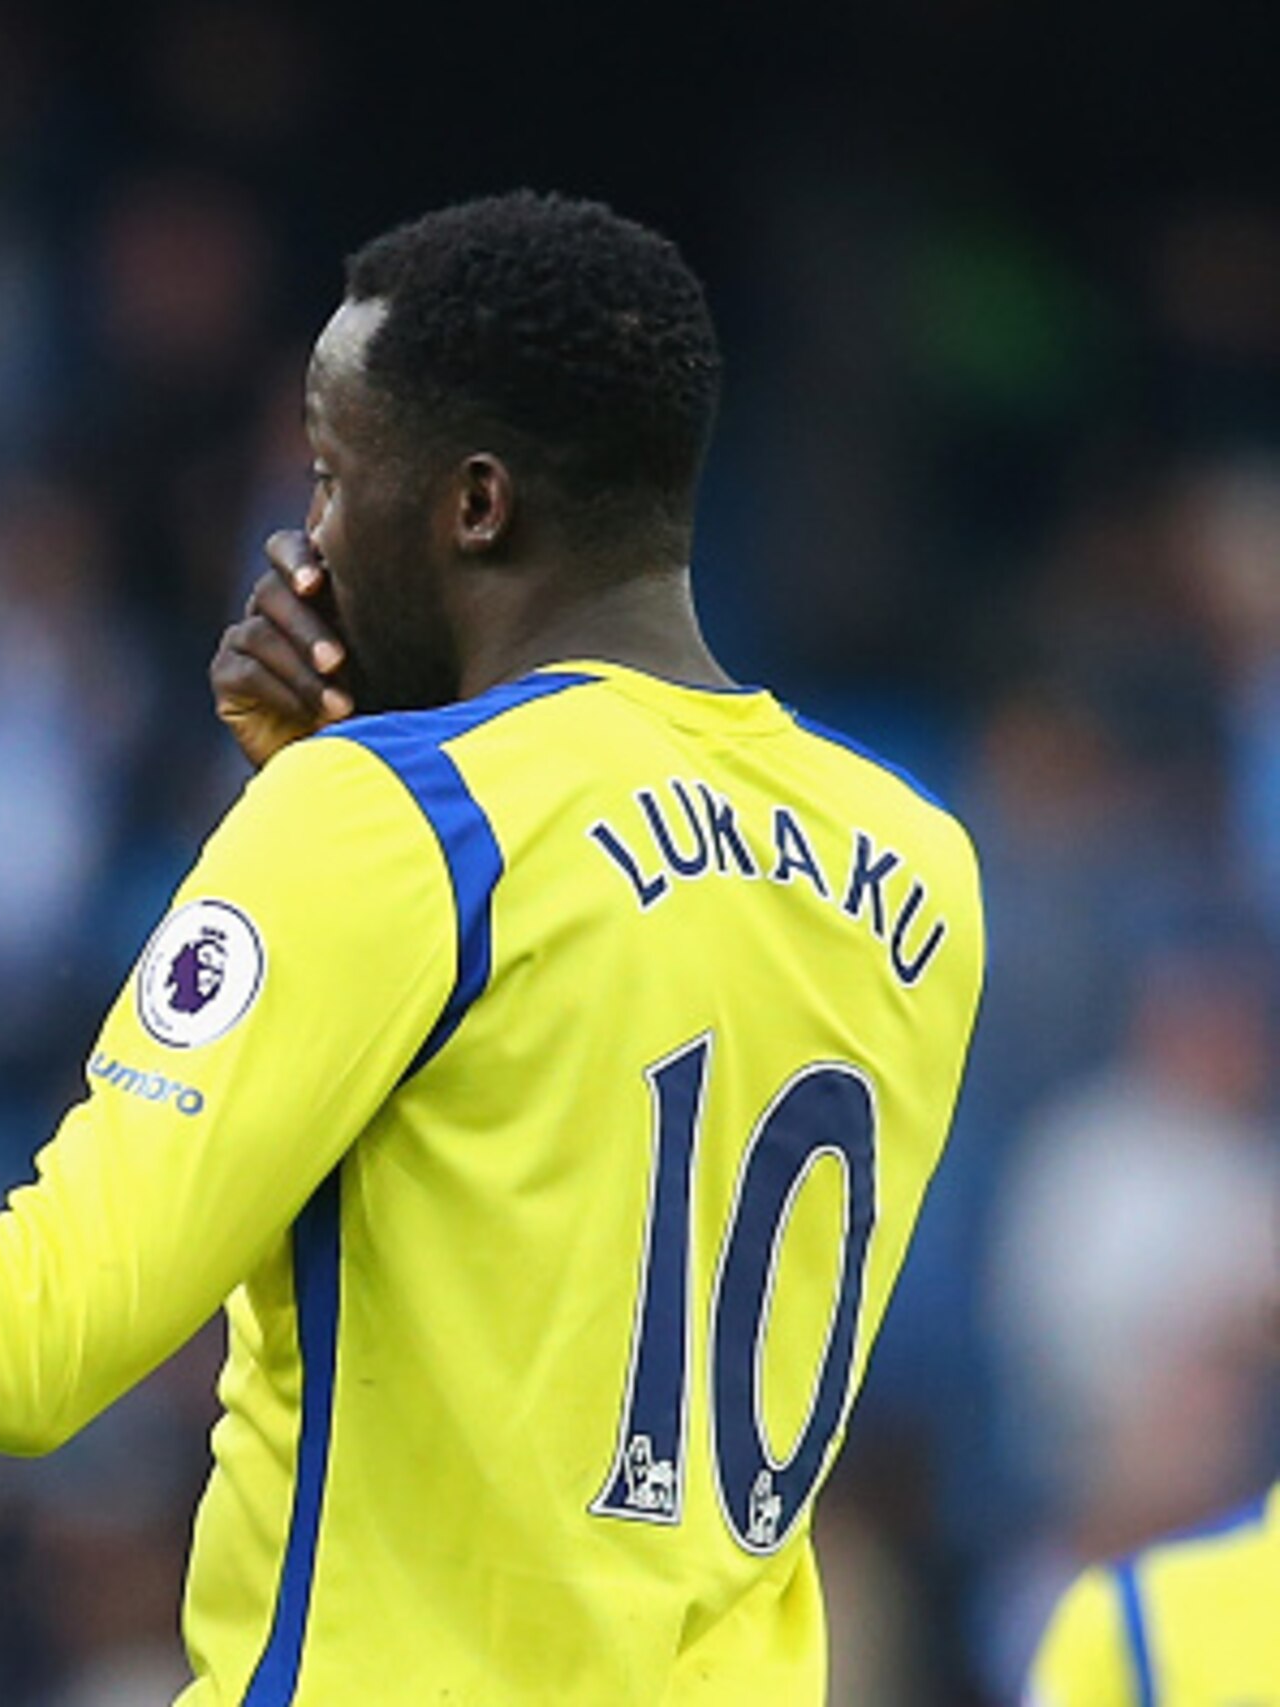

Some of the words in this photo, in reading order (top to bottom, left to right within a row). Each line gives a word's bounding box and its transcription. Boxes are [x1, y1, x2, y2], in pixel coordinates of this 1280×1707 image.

[589, 780, 946, 985] LUKAKU
[89, 1054, 204, 1116] umbro
[588, 1030, 877, 1556] 10
